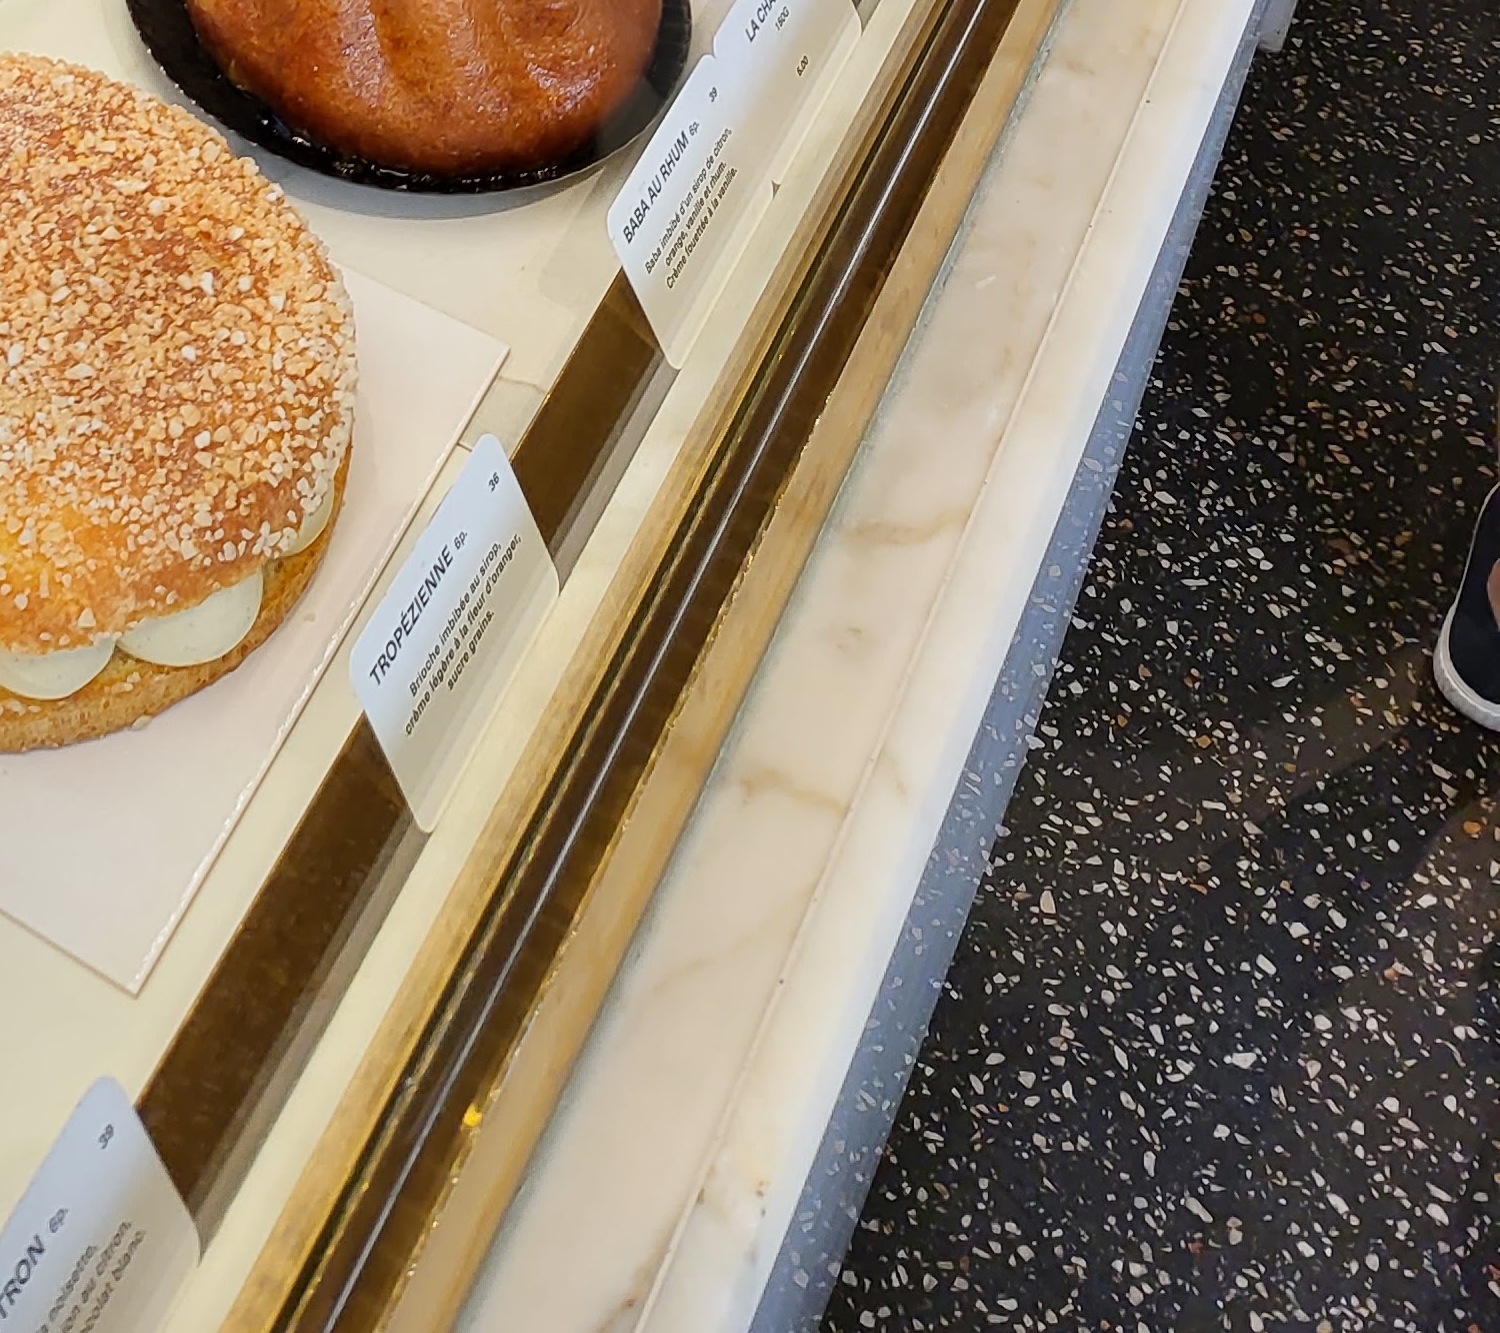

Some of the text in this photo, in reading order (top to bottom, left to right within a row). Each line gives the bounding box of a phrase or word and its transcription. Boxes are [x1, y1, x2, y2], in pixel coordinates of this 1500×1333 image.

[745, 18, 760, 43] LA
[622, 199, 650, 244] BABA
[647, 174, 662, 205] AU
[659, 130, 689, 183] RHUM
[644, 246, 662, 275] Baba
[659, 211, 681, 250] imbibé
[679, 191, 694, 216] d'un
[691, 167, 707, 195] sirop
[705, 155, 715, 170] de
[665, 161, 727, 267] orange, vanille et rhum.
[666, 167, 738, 290] Crème fouettée à la vanille.
[369, 471, 500, 686] TROPÉZIENNE 6p. 36
[405, 533, 522, 736] crème légère à la fleur d'oranger,
[409, 543, 502, 698] Brioche imbibée au sirop,
[447, 610, 495, 691] sucre grains.
